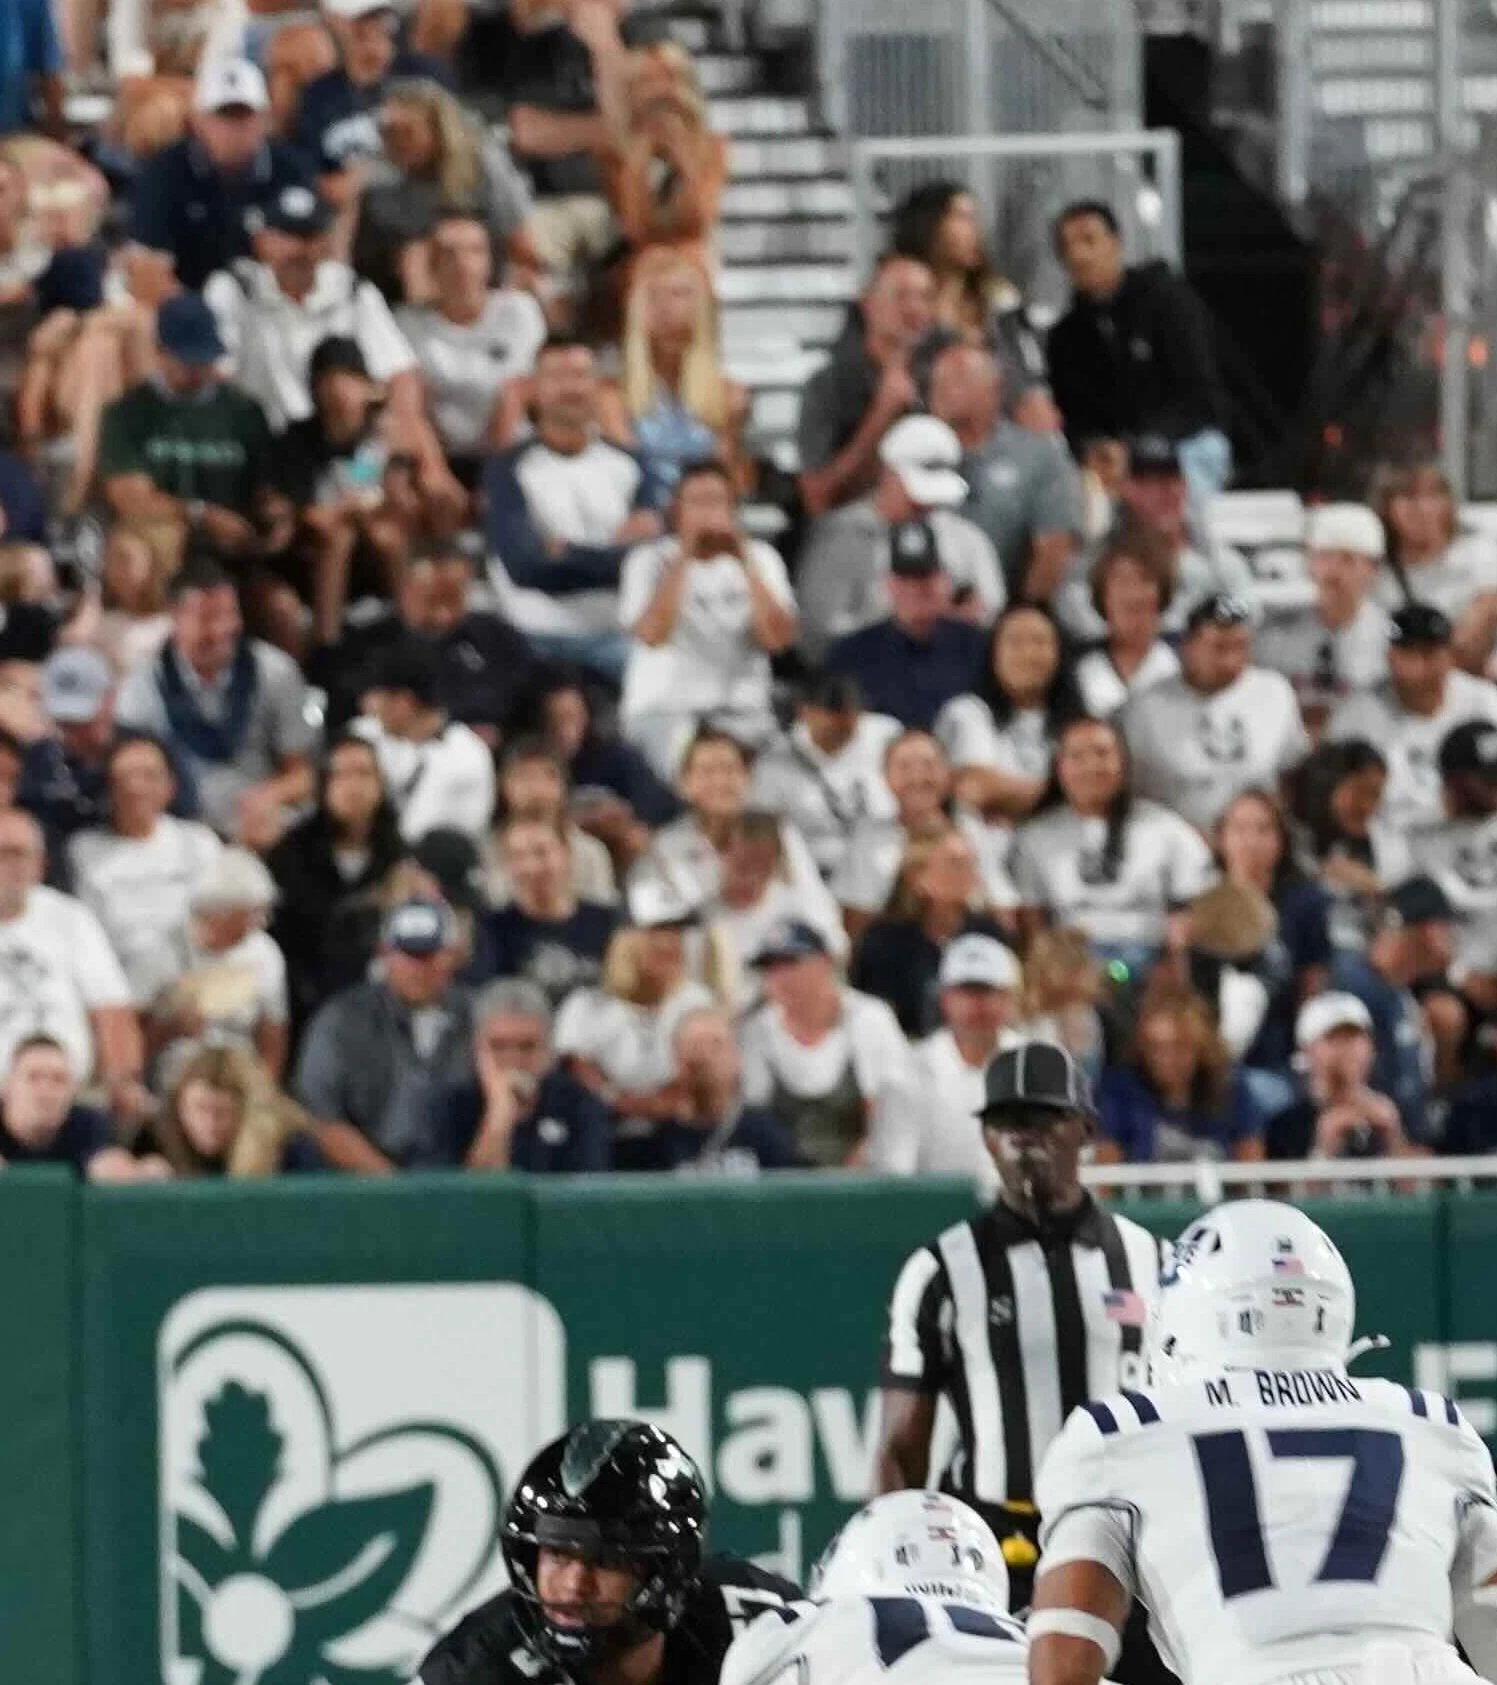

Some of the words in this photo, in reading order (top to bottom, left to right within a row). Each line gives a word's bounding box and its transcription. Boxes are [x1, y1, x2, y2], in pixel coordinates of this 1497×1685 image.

[1205, 1377, 1240, 1408] M.
[1255, 1369, 1364, 1407] BROWN
[1191, 1427, 1406, 1599] 17
